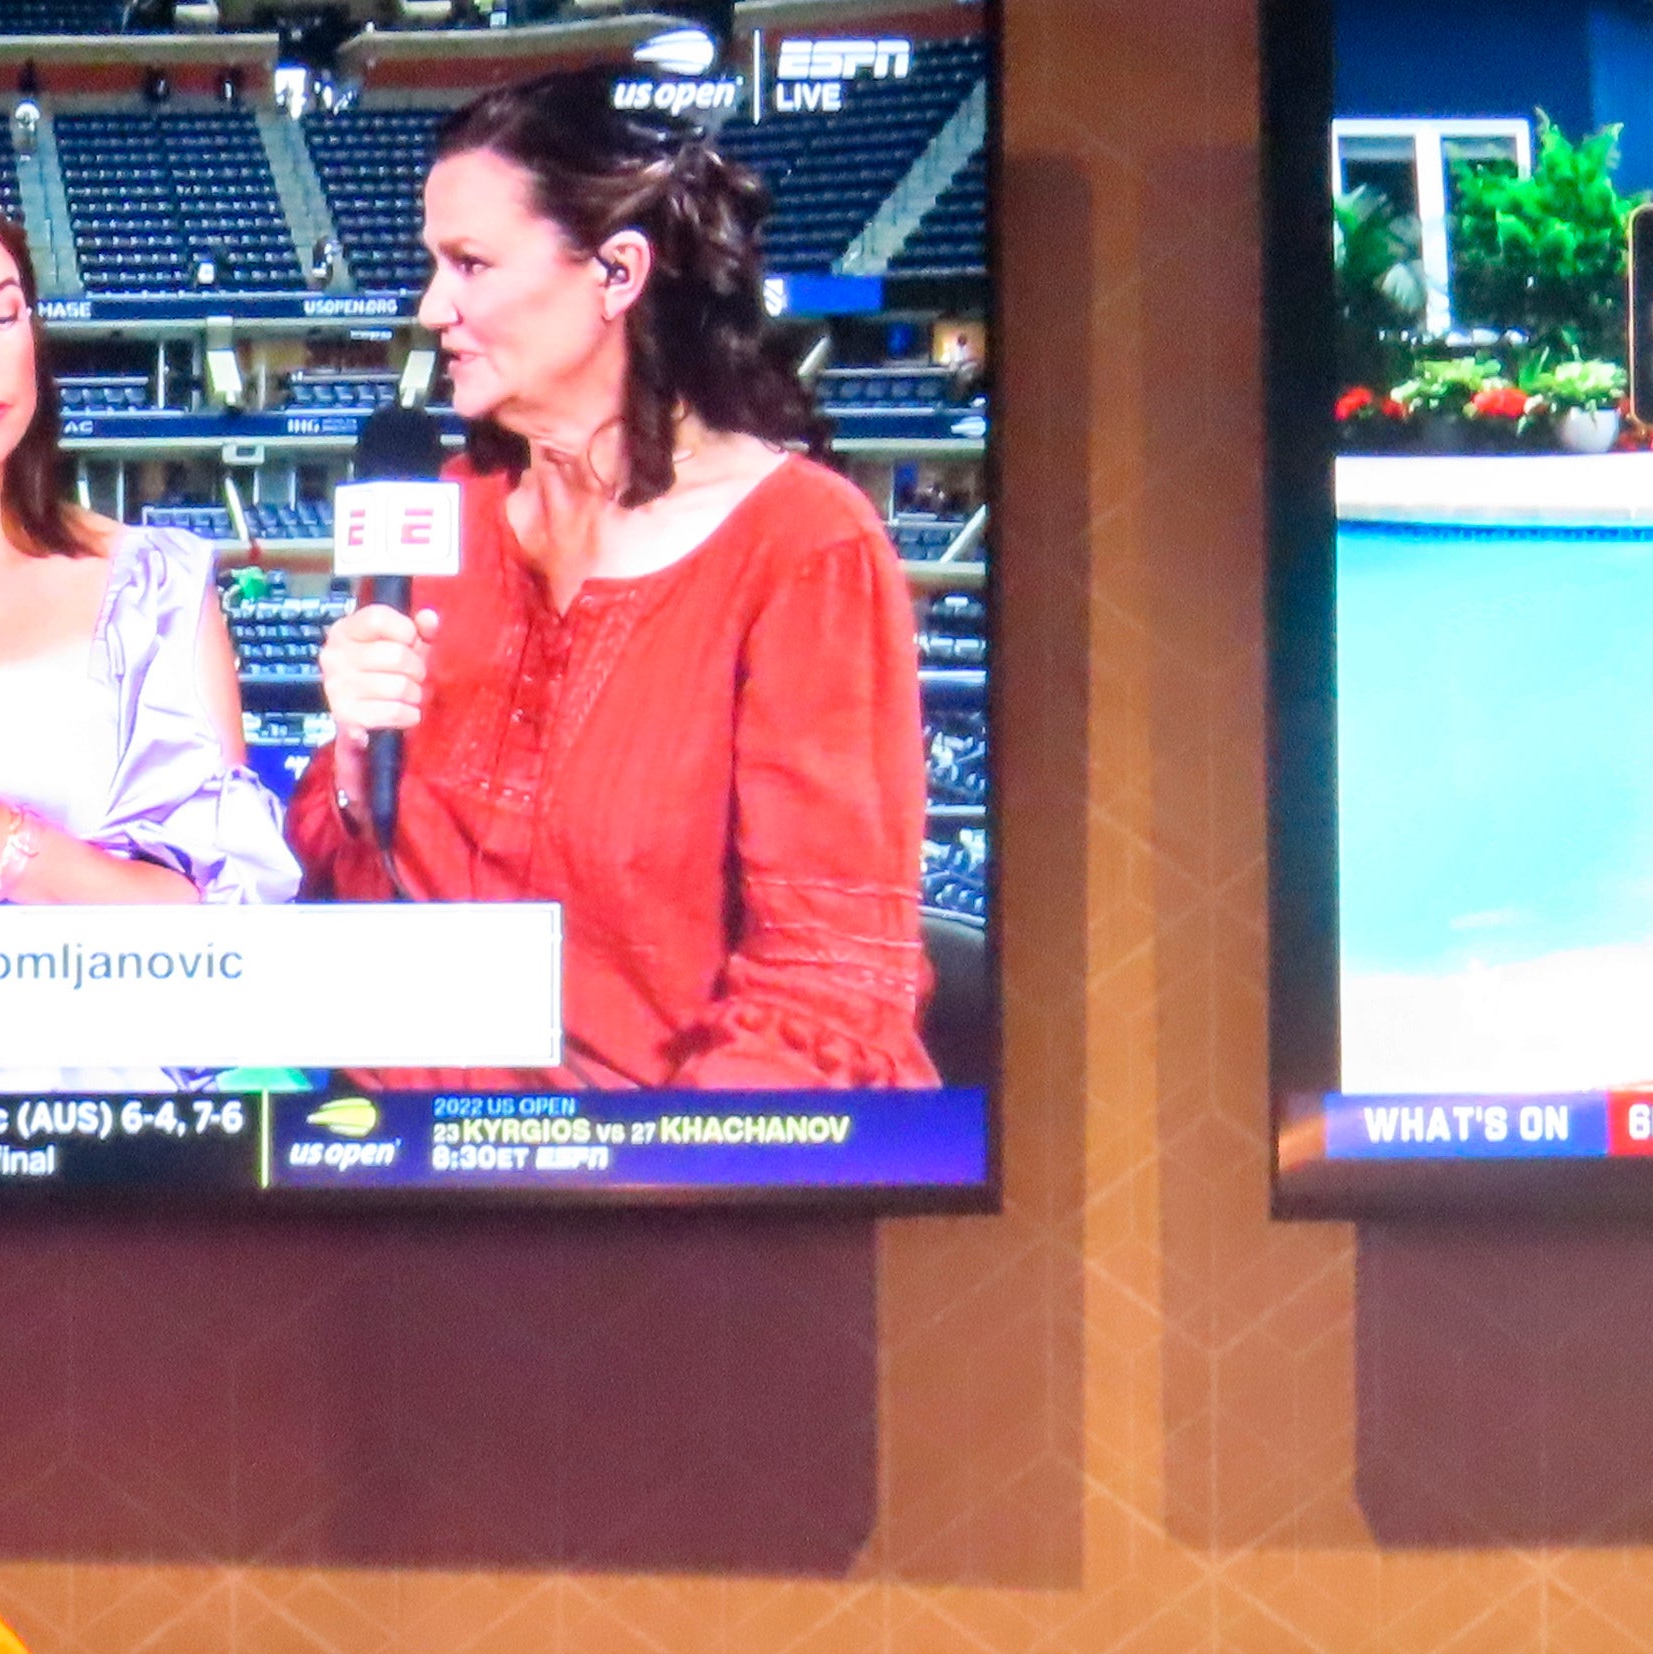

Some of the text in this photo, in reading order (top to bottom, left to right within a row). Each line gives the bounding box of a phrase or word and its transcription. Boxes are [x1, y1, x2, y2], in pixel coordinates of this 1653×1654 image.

[776, 37, 912, 80] ESPN
[614, 80, 735, 116] us open
[776, 82, 843, 112] LIVE
[37, 301, 92, 318] HASE
[16, 1101, 113, 1140] (AUS)
[120, 1101, 186, 1137] 6-4,
[193, 1101, 244, 1133] 7-6
[433, 1096, 576, 1116] 2022 US OPEN
[433, 1122, 460, 1143] 23
[462, 1117, 592, 1144] KYRGIOS
[630, 1122, 656, 1145] 27
[660, 1115, 850, 1144] KHACHANOV
[1363, 1103, 1570, 1143] WHAT'S ON
[289, 1142, 395, 1172] us open
[534, 1145, 610, 1170] ESPN
